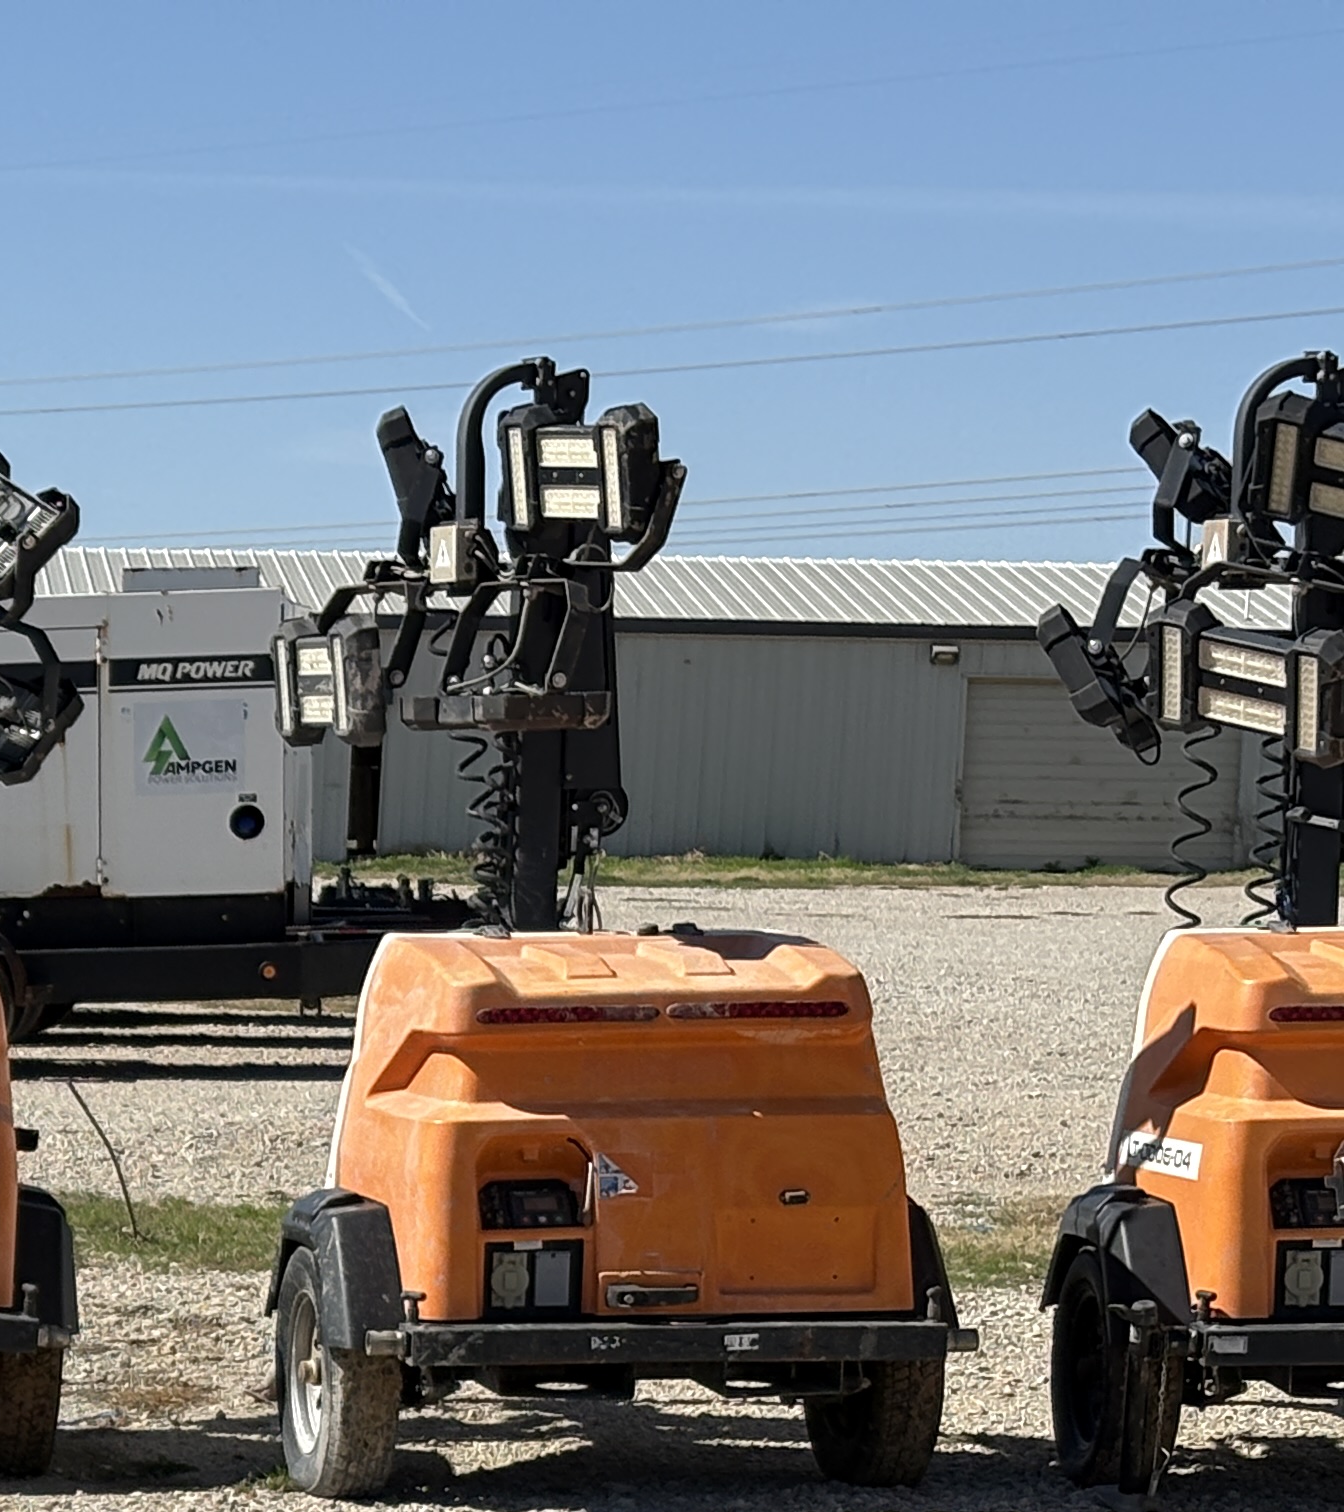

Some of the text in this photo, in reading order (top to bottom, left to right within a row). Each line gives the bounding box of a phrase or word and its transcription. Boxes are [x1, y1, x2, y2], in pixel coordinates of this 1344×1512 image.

[137, 660, 255, 682] MQ POWER
[164, 759, 237, 775] AMPGEN
